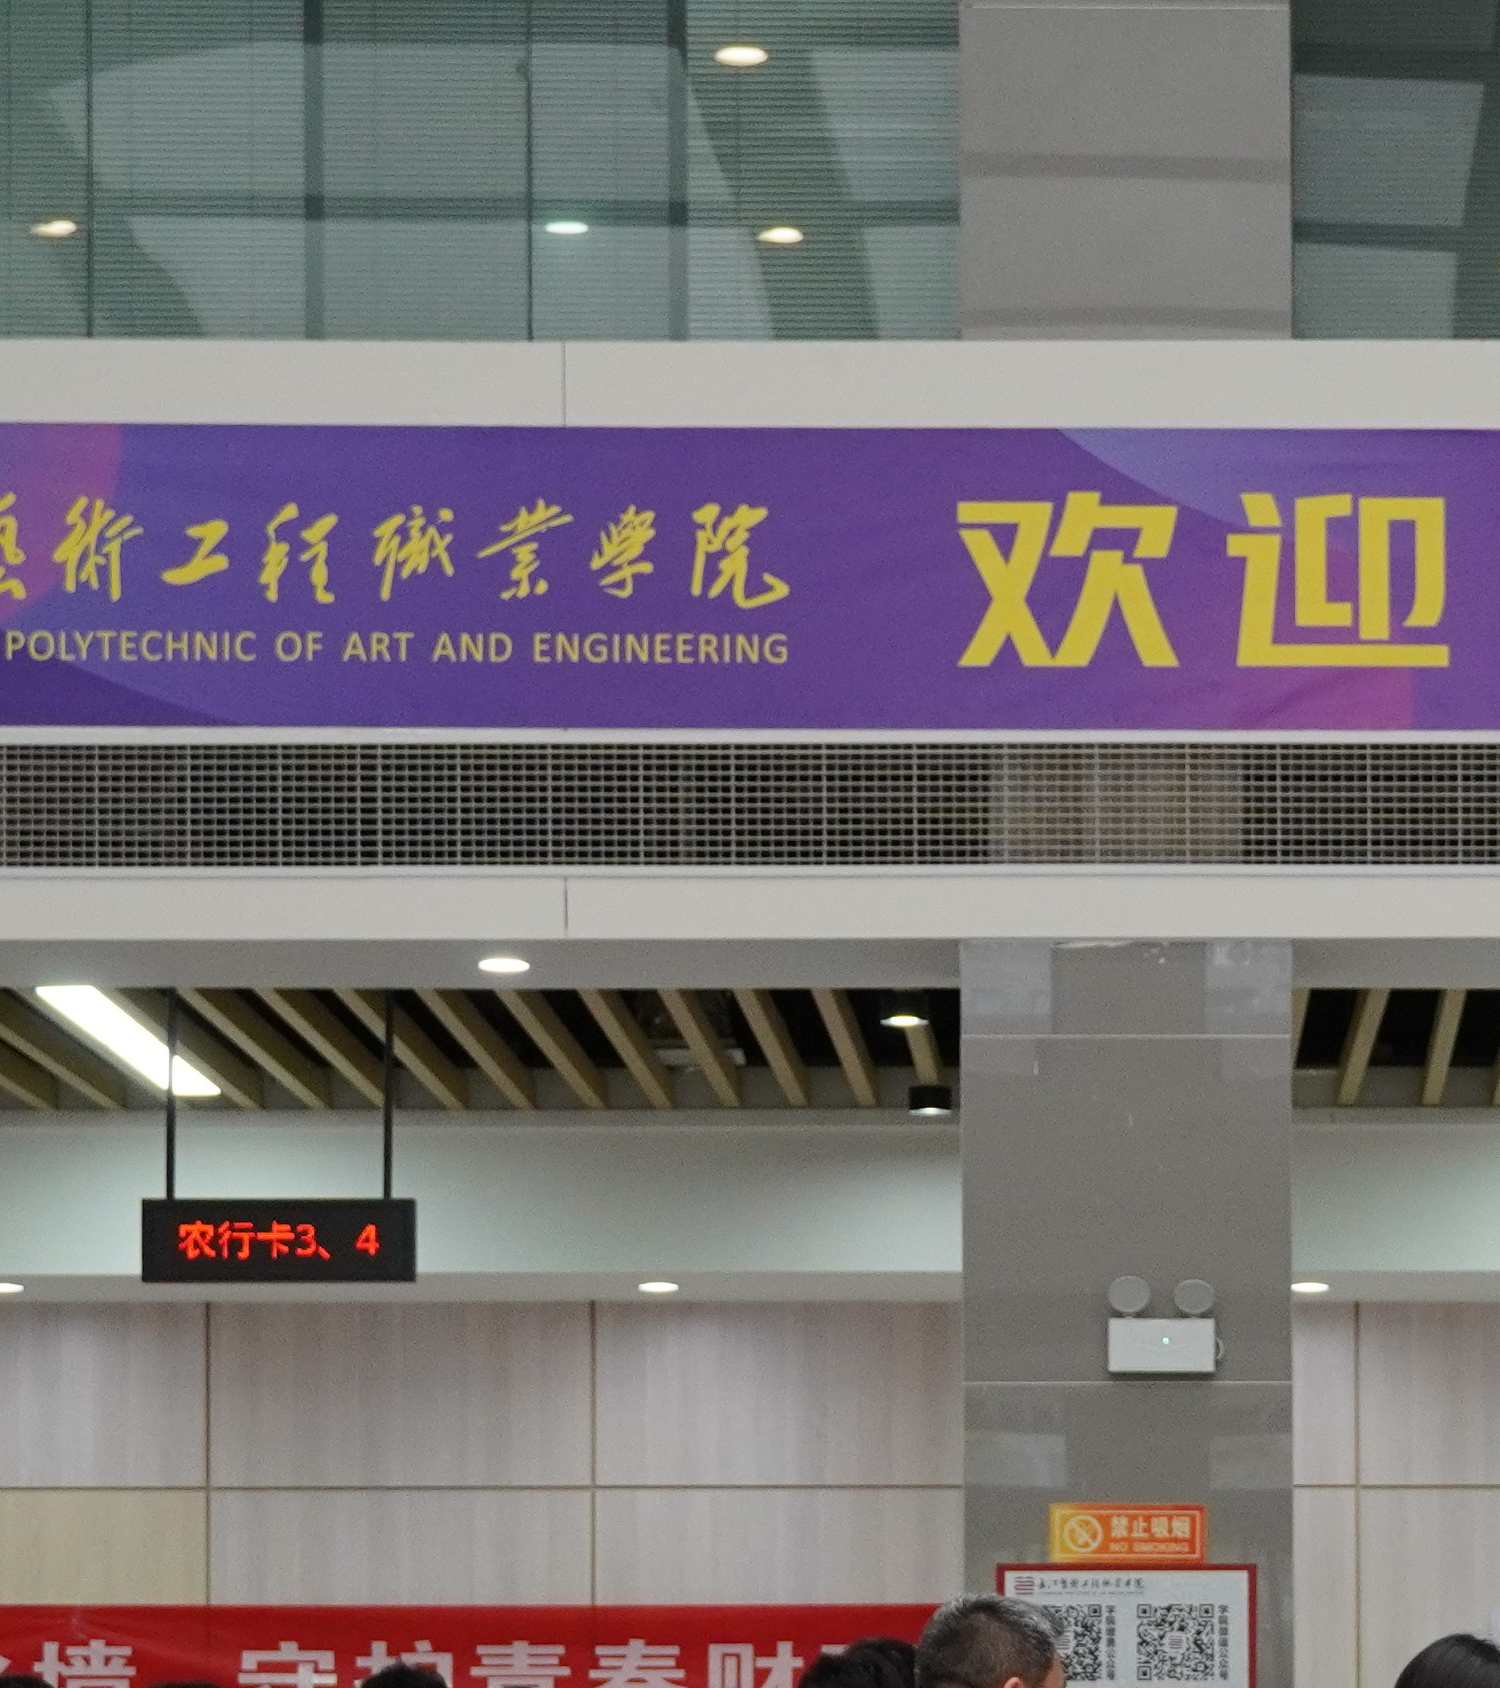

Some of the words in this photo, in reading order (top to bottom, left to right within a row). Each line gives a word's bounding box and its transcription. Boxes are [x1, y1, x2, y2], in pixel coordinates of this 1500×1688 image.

[956, 491, 1450, 669] 欢迎
[5, 631, 257, 662] POLYTECHNIC
[276, 631, 324, 662] OF
[342, 631, 415, 662] ART
[431, 631, 513, 662] AND
[532, 633, 791, 665] ENGINEERING
[1110, 1515, 1191, 1539] 禁止吸烟
